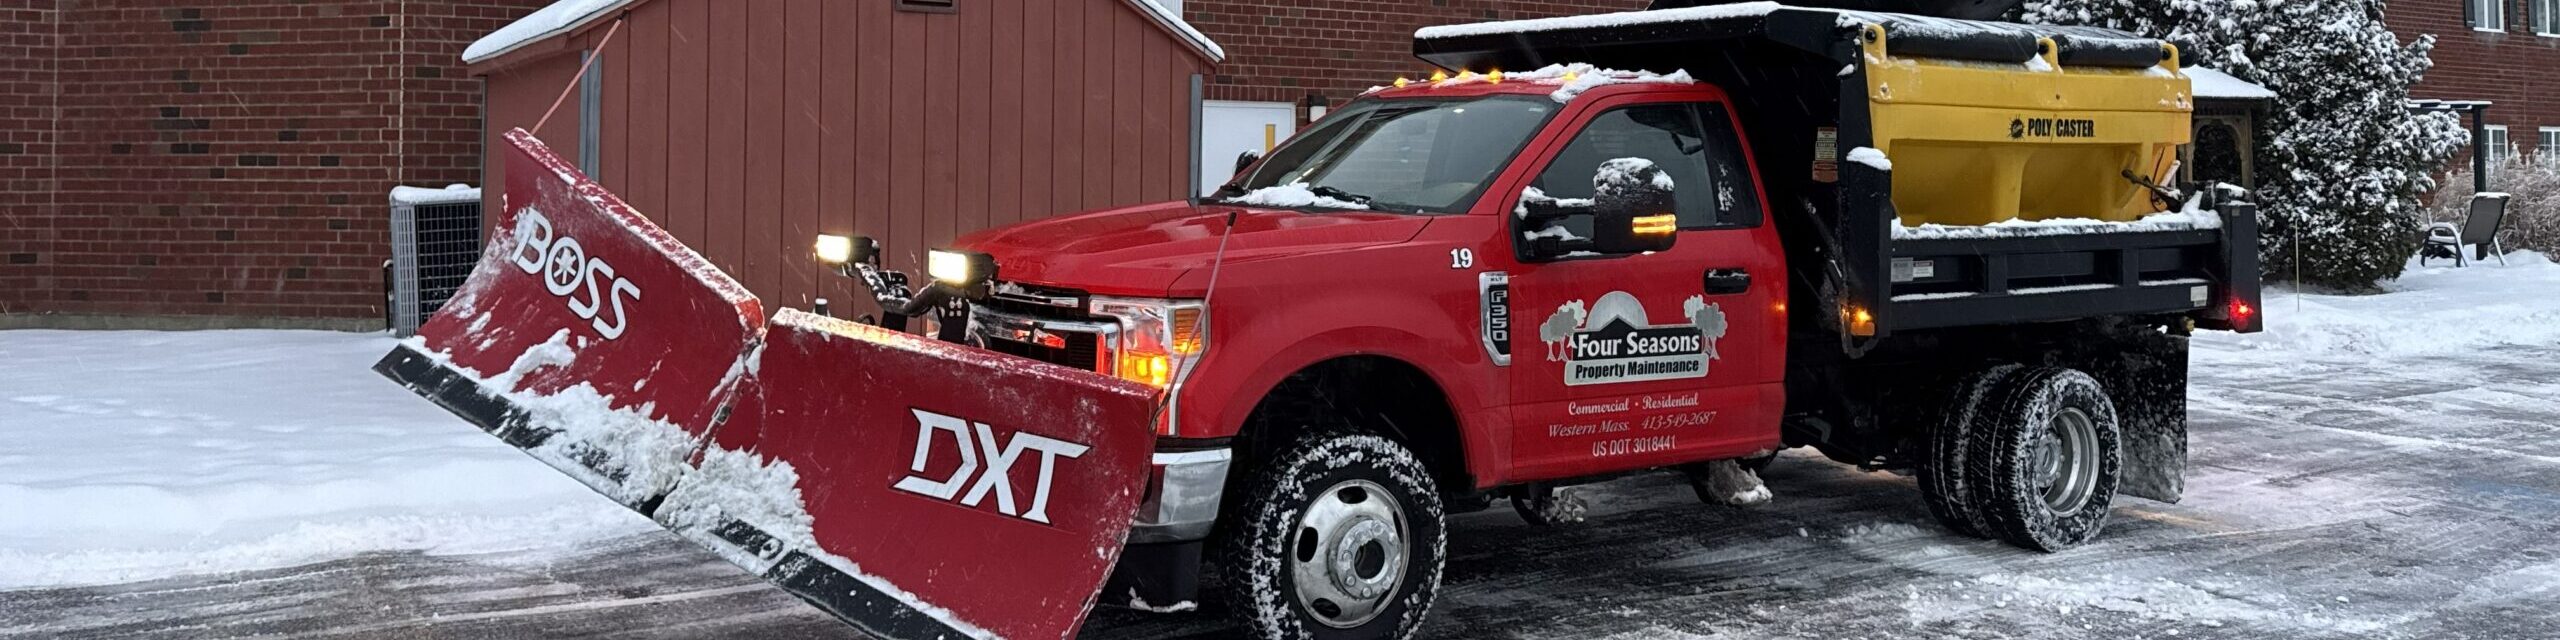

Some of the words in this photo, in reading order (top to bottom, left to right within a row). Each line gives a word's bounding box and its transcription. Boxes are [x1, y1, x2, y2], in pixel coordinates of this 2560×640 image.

[2027, 118, 2052, 136] POLY
[2056, 118, 2094, 137] CASTER
[1450, 248, 1473, 268] 19
[511, 206, 641, 340] BOSS
[1578, 334, 1621, 357] Four
[1626, 331, 1699, 355] Seasons
[1575, 364, 1625, 379] Property
[1627, 359, 1699, 376] Maintenance
[1568, 398, 1629, 415] Commercial
[1642, 392, 1699, 410] Residential
[1549, 423, 1595, 437] Western
[1599, 420, 1630, 433] Mass.
[1641, 411, 1717, 430] 413-549-2687
[1592, 440, 1607, 457] US
[1610, 438, 1631, 455] DOT
[1633, 435, 1676, 453] 3018441
[892, 408, 1091, 524] DXT
